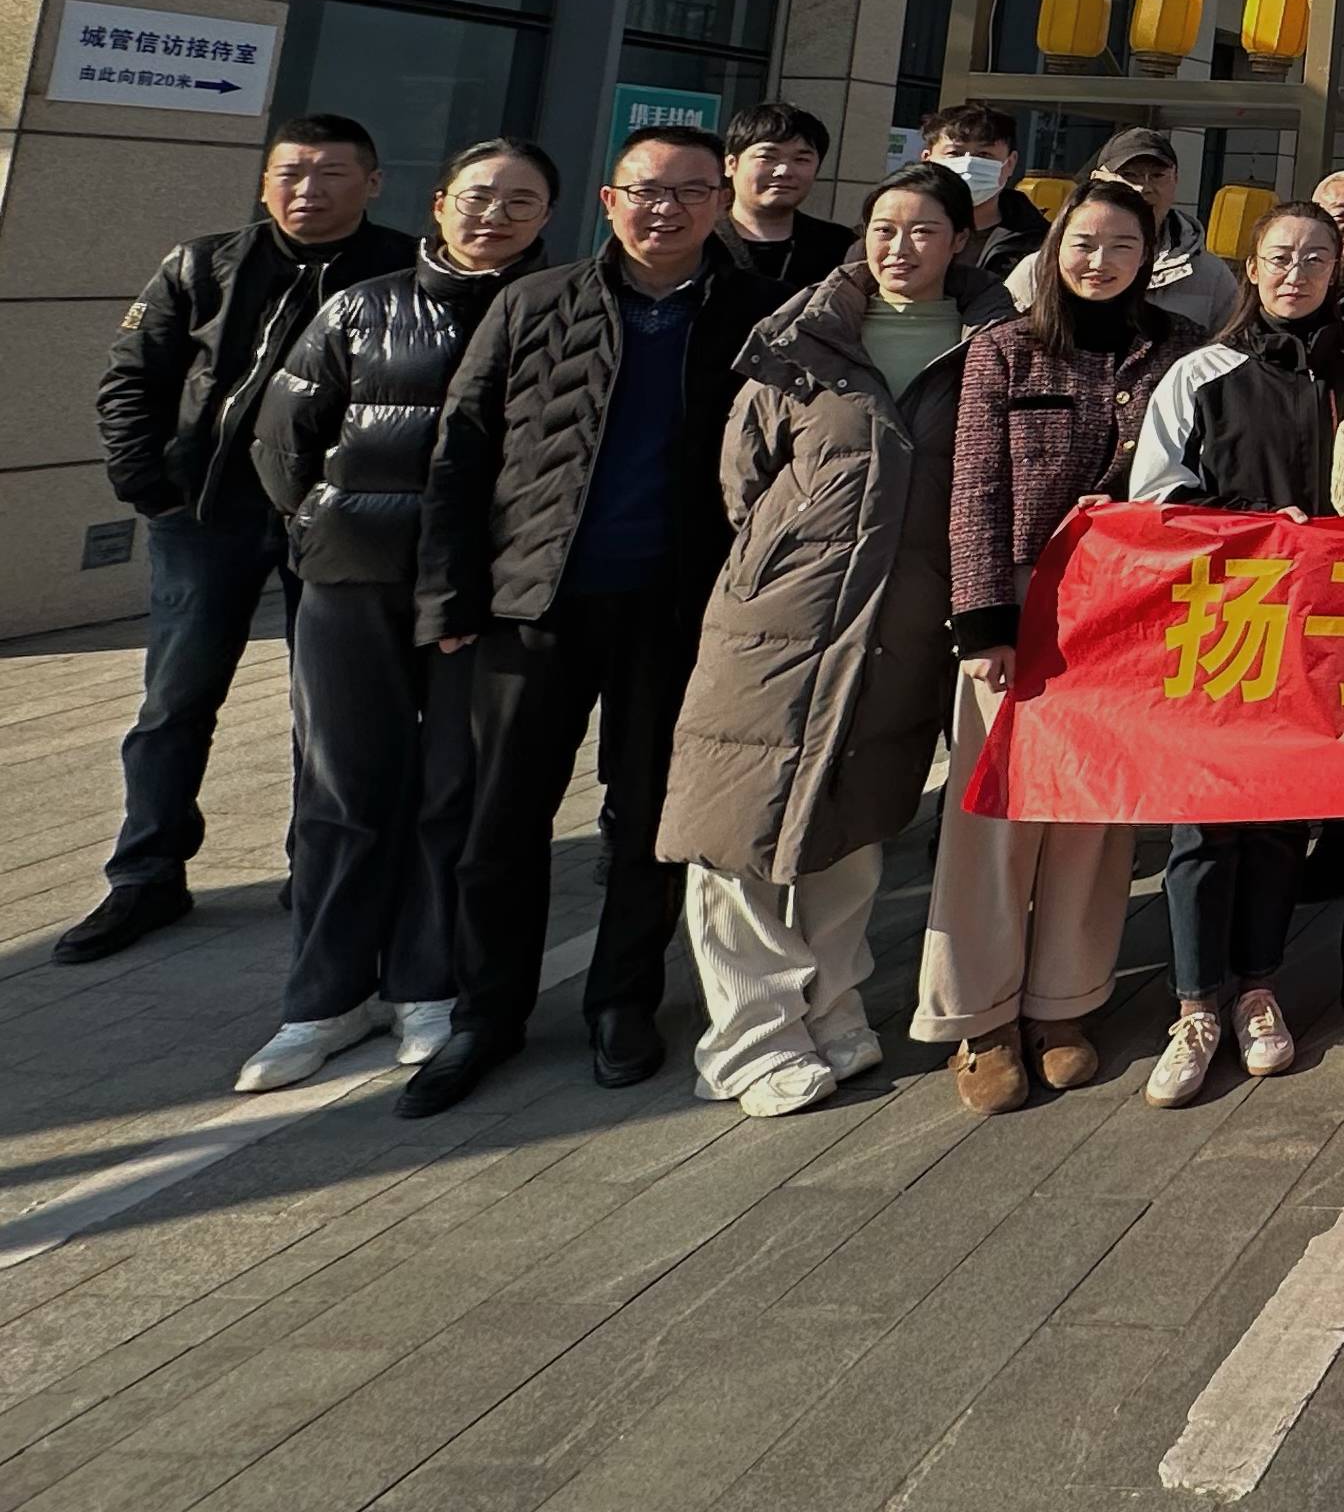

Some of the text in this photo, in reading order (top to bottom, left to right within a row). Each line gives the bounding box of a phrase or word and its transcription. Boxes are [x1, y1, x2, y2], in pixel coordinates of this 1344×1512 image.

[79, 25, 258, 66] 城管信访接待室
[78, 64, 193, 90] 由此向前20米
